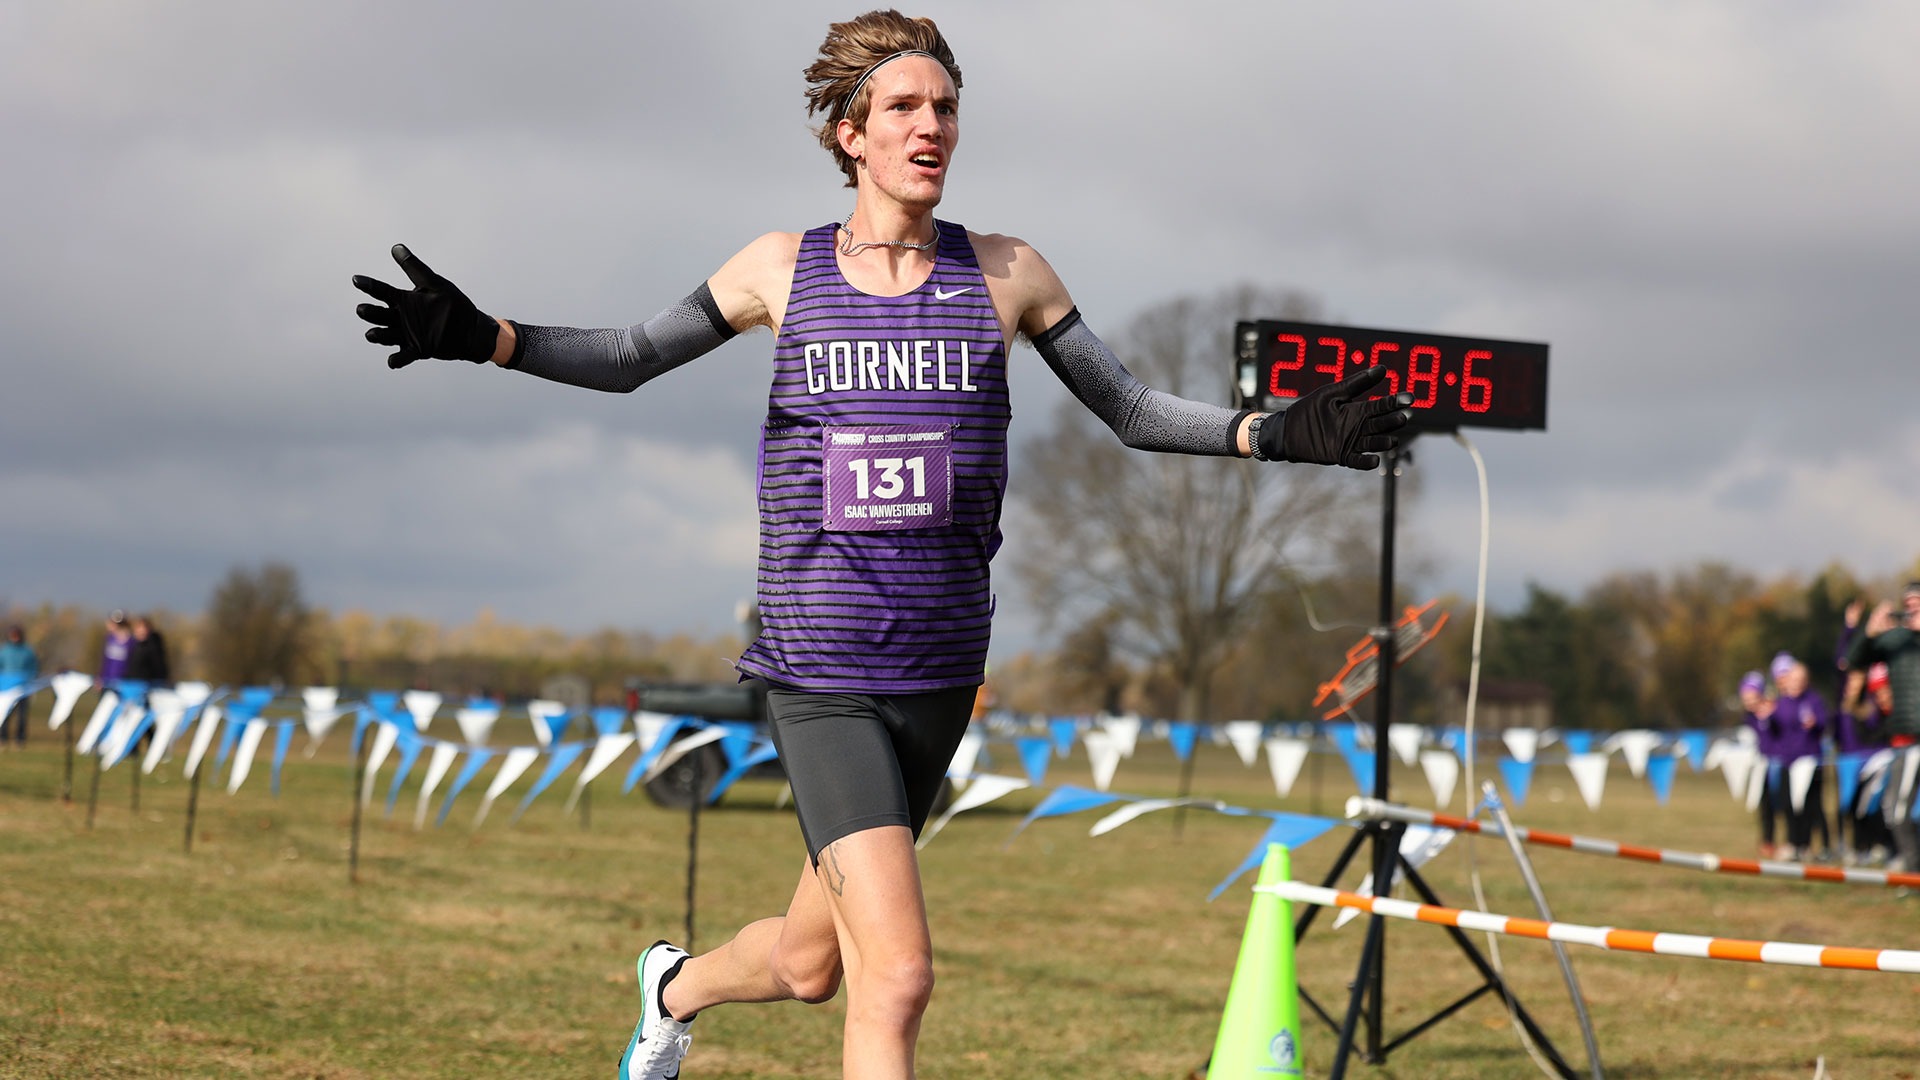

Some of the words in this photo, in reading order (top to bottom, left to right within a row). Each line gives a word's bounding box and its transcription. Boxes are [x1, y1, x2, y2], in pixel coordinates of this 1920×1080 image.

[803, 339, 979, 396] CORNELL
[868, 434, 885, 443] CROSS
[885, 433, 907, 443] COUNTRY
[848, 456, 926, 499] 131
[844, 505, 868, 518] ISAAC
[869, 503, 933, 518] VANWESTRIENEN
